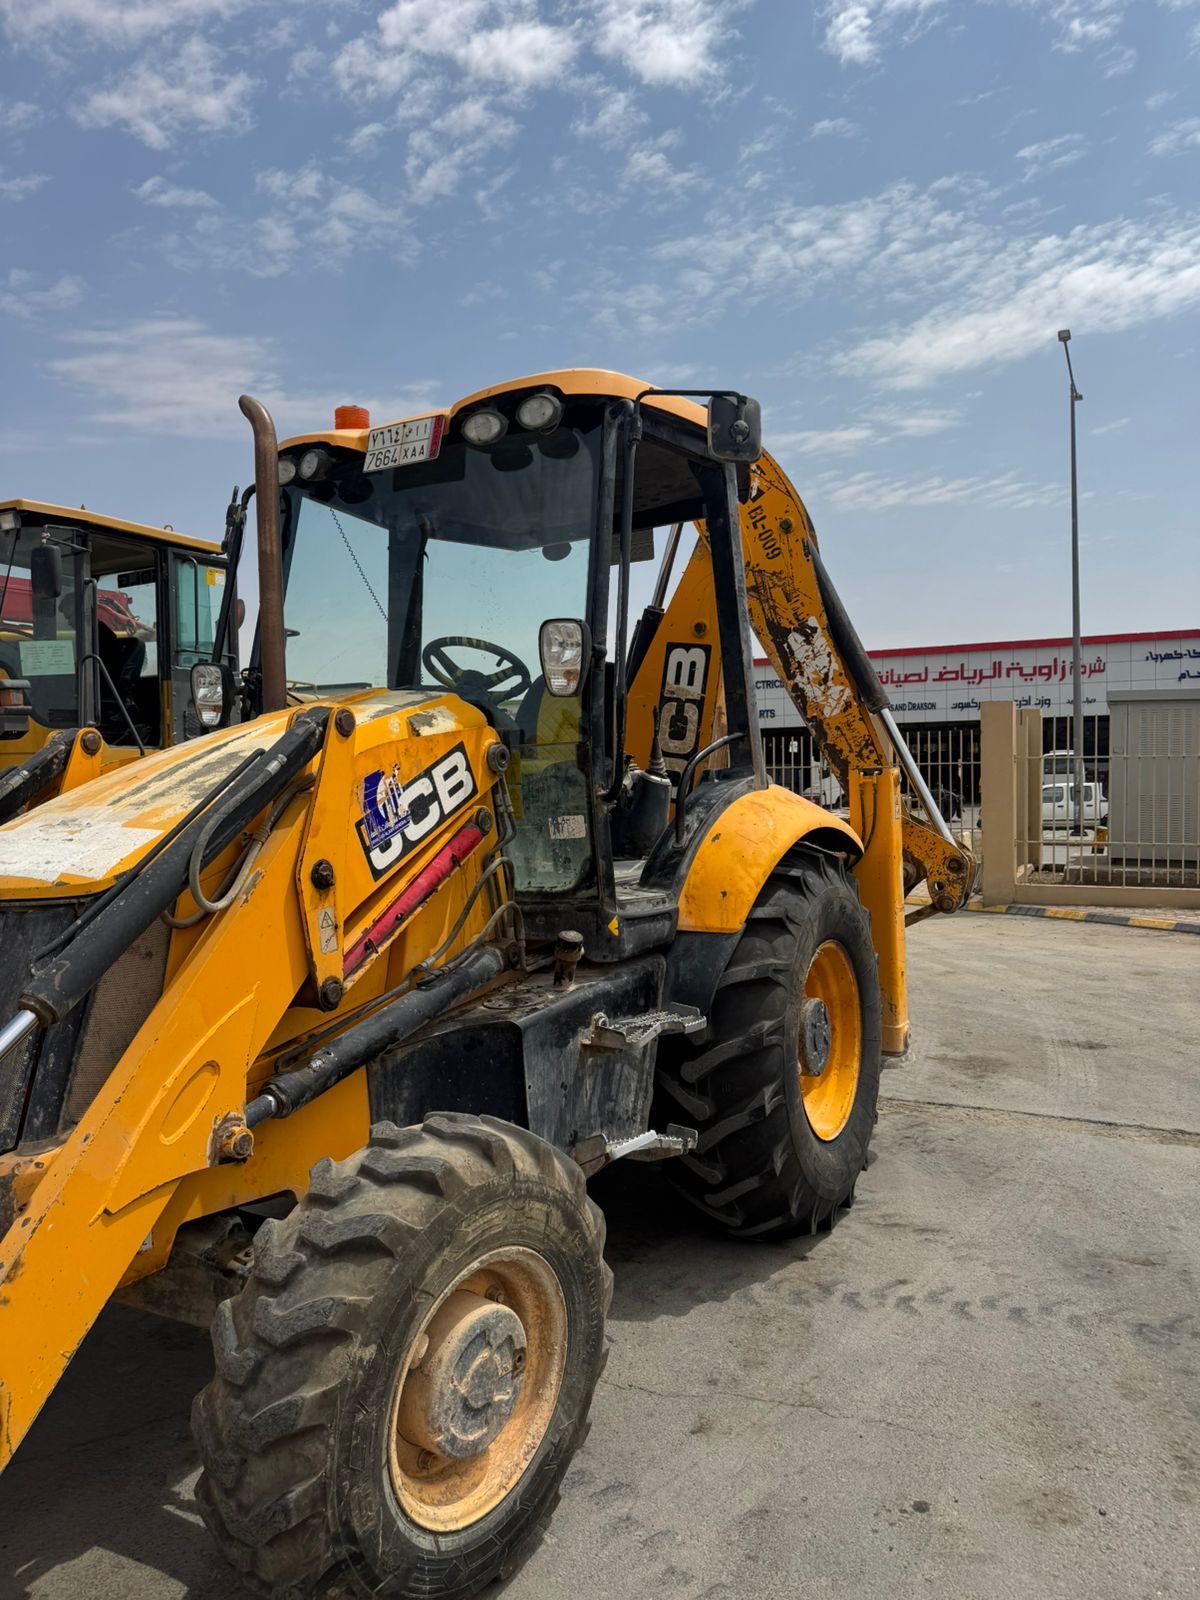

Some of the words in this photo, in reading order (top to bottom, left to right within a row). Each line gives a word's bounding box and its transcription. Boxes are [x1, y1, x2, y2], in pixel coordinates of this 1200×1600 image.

[367, 448, 397, 470] 7664
[403, 444, 425, 460] XAA
[747, 505, 782, 560] BL-009
[932, 660, 1002, 685] الرياض
[1006, 657, 1066, 682] زاوية
[759, 709, 776, 719] RTS
[370, 751, 474, 870] JCB
